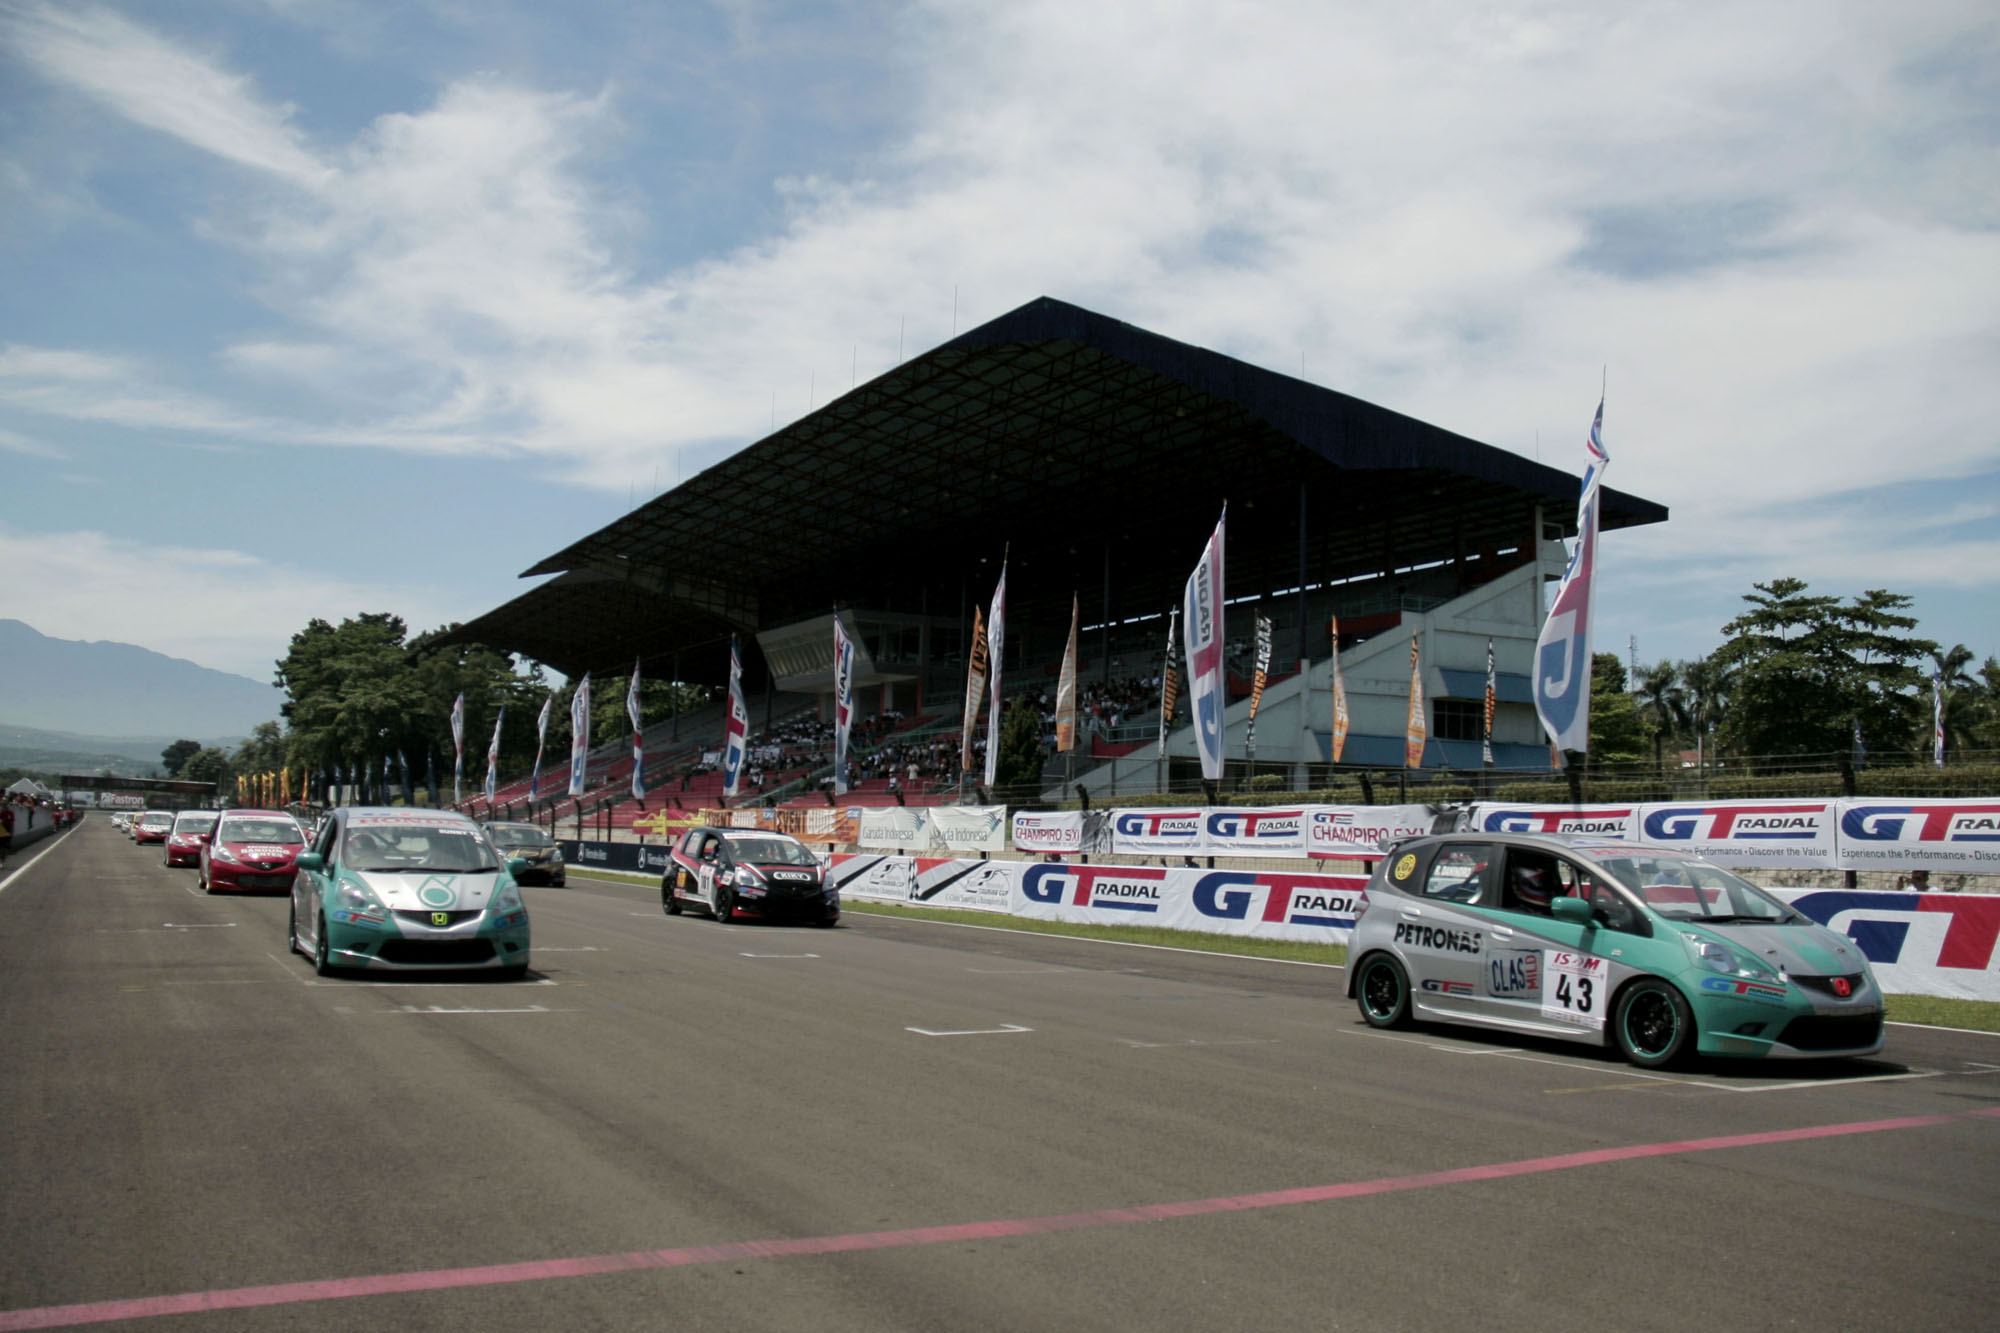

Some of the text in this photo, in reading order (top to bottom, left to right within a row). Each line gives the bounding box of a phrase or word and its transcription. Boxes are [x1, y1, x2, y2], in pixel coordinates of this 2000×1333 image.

[1016, 828, 1063, 841] CHAMPIRO
[1116, 812, 1201, 836] GT RADIAL
[1207, 811, 1304, 837] GT RADIAL
[1313, 826, 1389, 843] CHAMPIRO
[1561, 822, 1627, 833] RADIAL
[1644, 805, 1827, 839] GT RADIAL
[1841, 805, 2000, 841] GT RA
[1694, 847, 1743, 856] Performance
[1749, 847, 1784, 856] Discover
[1787, 848, 1799, 856] the
[1803, 847, 1828, 856] Value
[1842, 849, 1886, 859] Experience
[1888, 850, 1901, 858] the
[1905, 850, 1966, 860] Performance
[1022, 863, 1166, 906] GT
[1095, 883, 1160, 899] RADIAL
[1193, 872, 1369, 923] GT
[1394, 922, 1482, 954] PETRONAS
[1790, 891, 2000, 970] GT
[1492, 957, 1526, 992] CLAS
[1525, 954, 1539, 990] MILD
[1556, 973, 1593, 1013] 43
